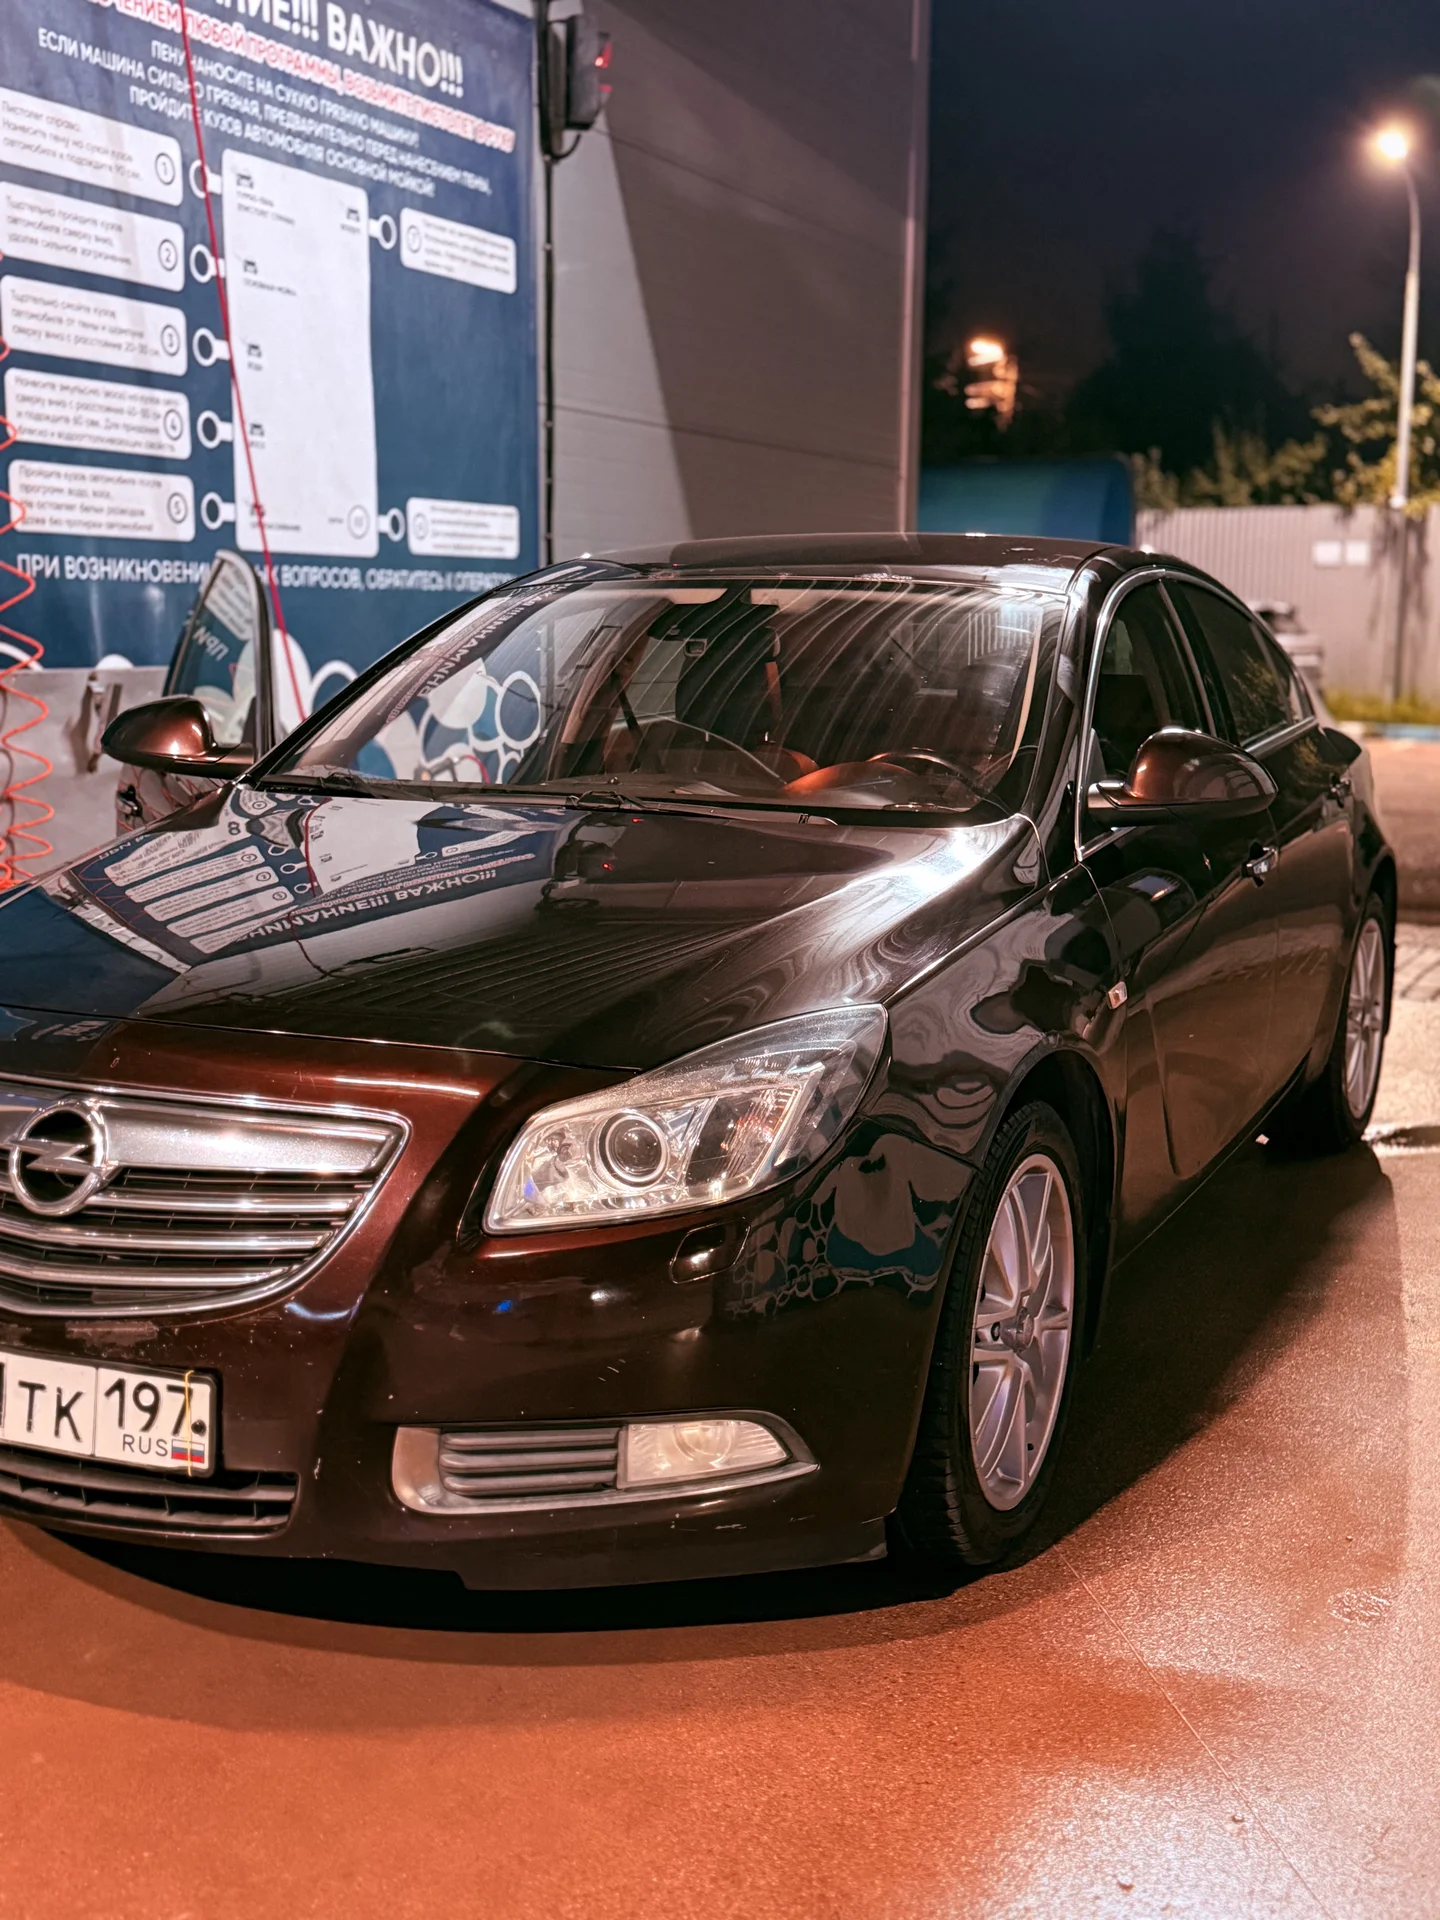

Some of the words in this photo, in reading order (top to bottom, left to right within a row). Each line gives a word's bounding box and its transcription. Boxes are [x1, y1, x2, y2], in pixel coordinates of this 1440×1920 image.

[37, 26, 78, 58] ЕСЛИ
[79, 40, 144, 81] МАШИНА
[151, 39, 185, 68] ПЕНУ
[255, 76, 274, 98] НА
[326, 2, 464, 98] ВАЖНО!!!
[17, 554, 60, 579] ПРИ
[280, 564, 364, 591] ВОПРОСОВ,
[104, 1378, 193, 1437] 197
[122, 1433, 168, 1457] RUS
